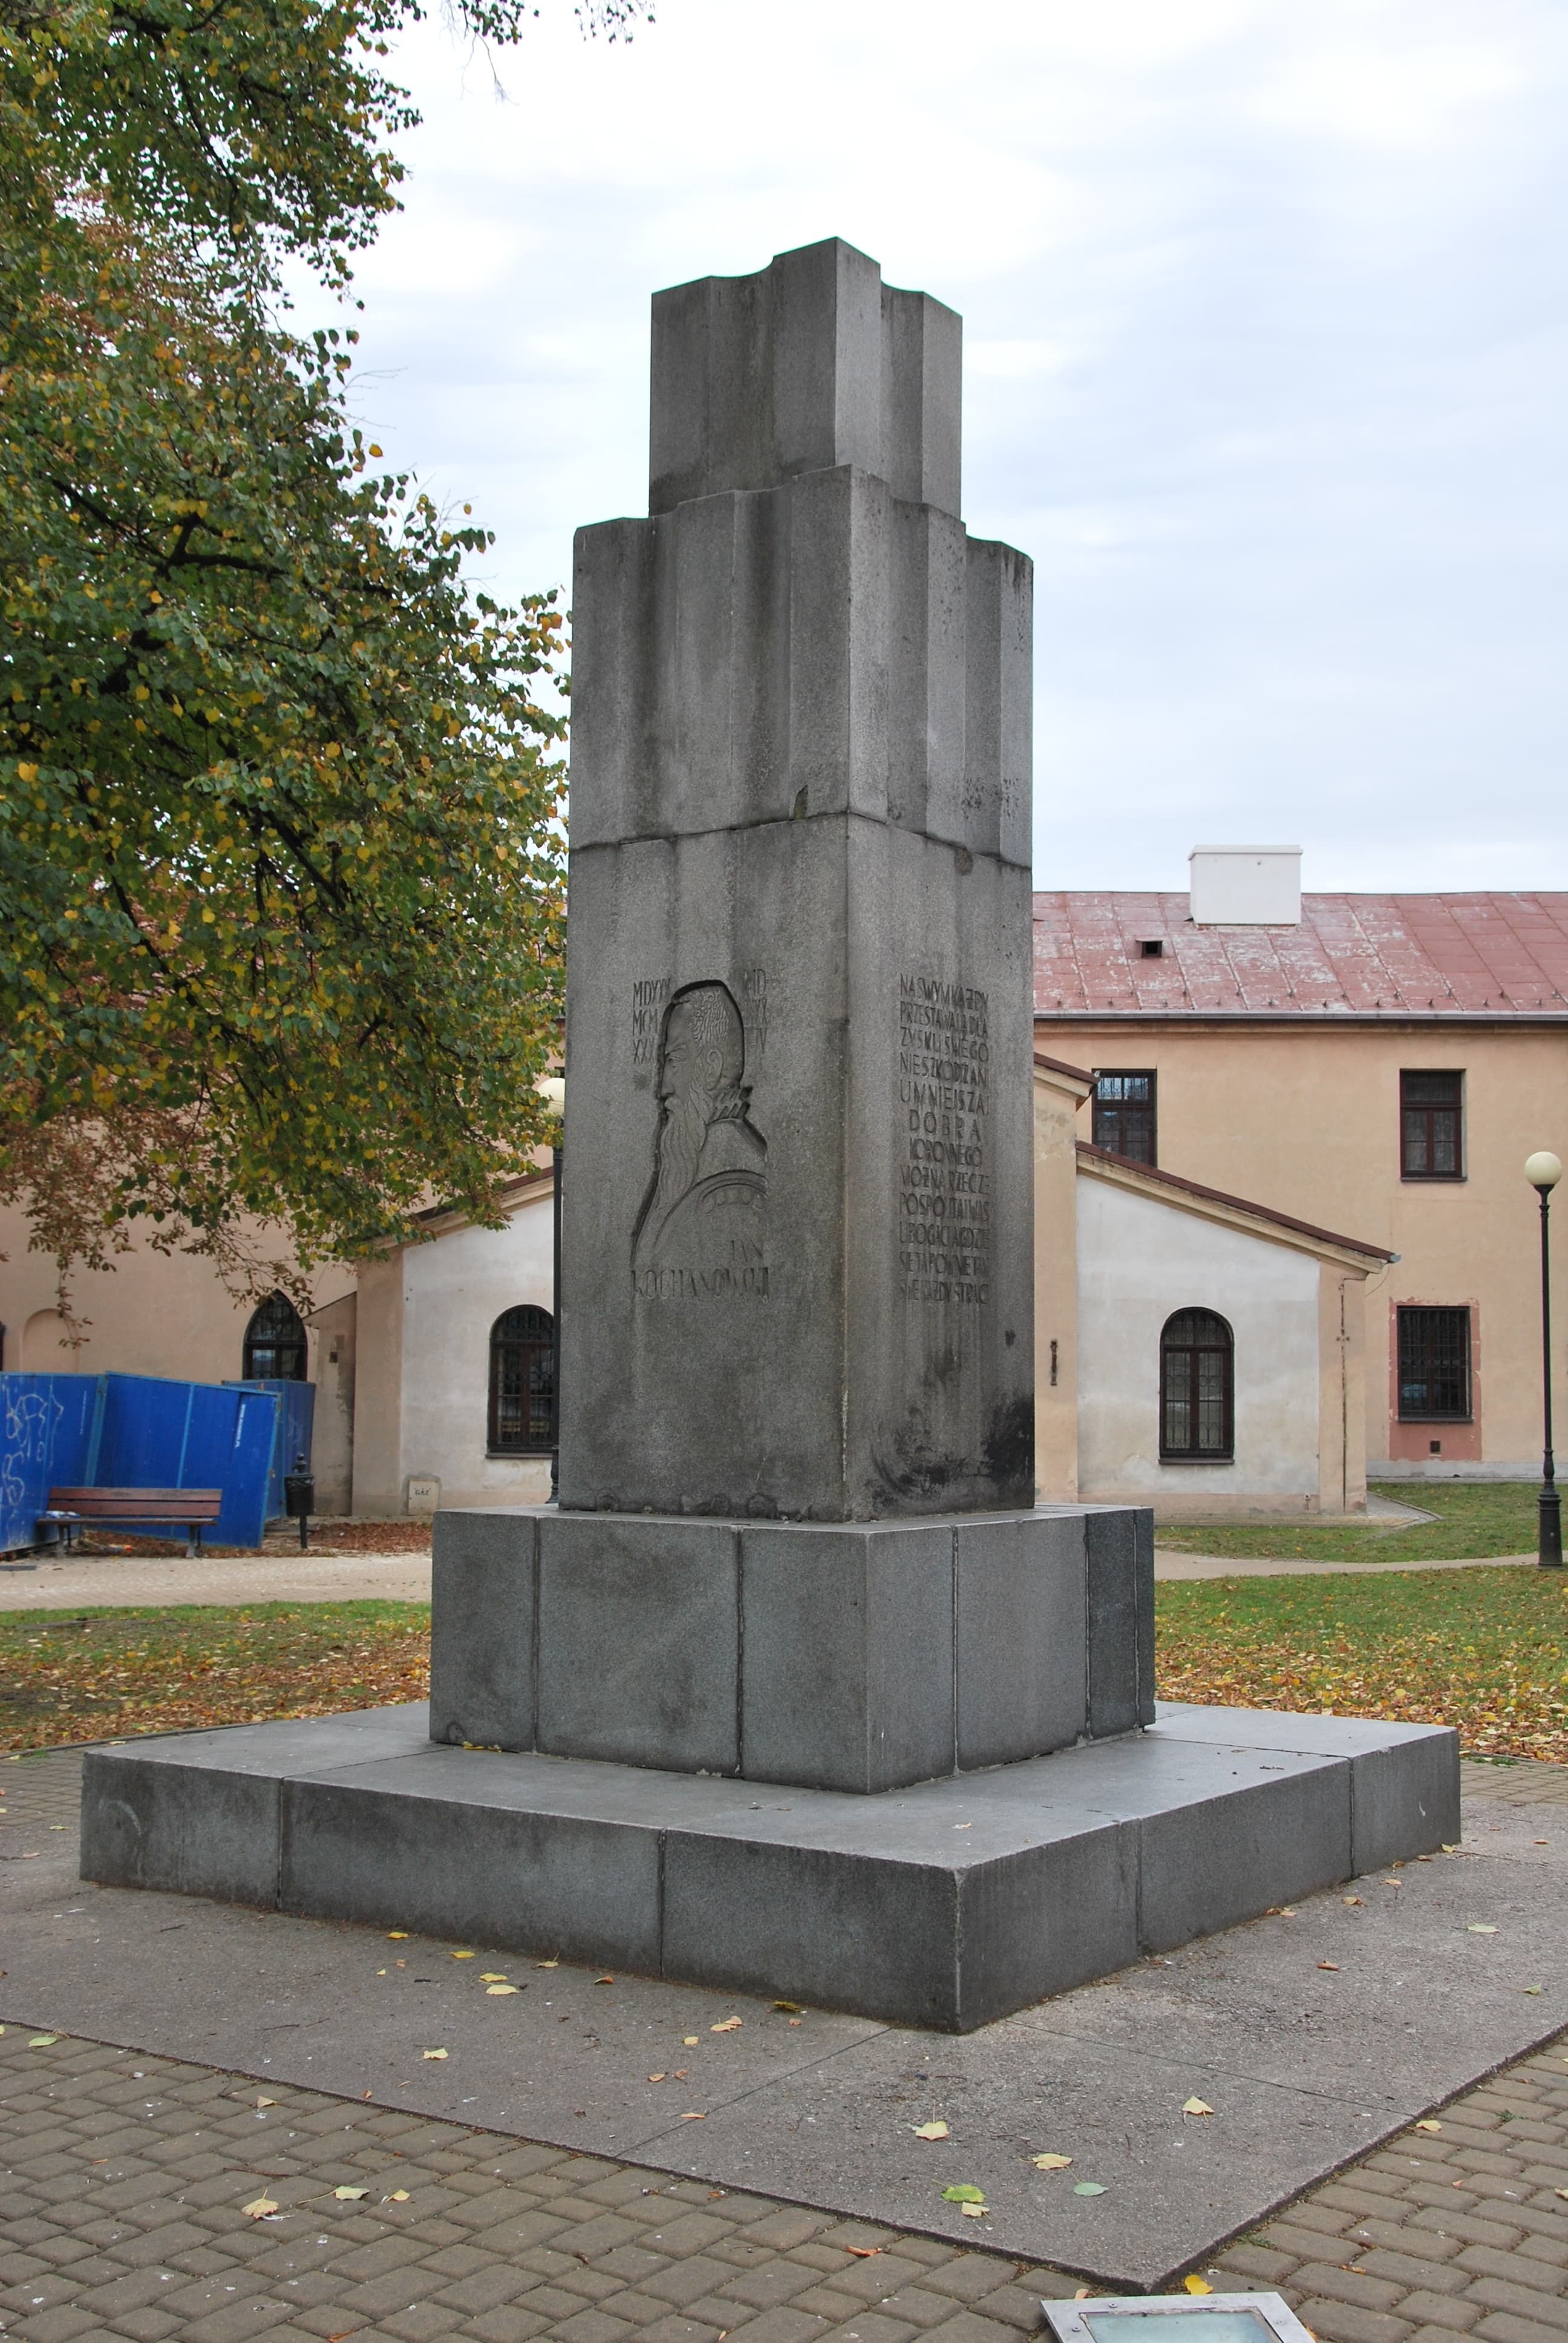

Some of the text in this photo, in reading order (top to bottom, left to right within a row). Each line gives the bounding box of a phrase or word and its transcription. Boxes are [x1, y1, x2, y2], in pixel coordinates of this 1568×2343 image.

[900, 973, 915, 997] NA
[633, 1009, 658, 1036] MCM
[969, 1016, 989, 1039] DLA
[633, 1038, 655, 1064] XXX
[900, 1026, 990, 1063] ZYSKU SWEGO
[900, 1052, 920, 1075] NIE
[970, 1066, 990, 1090] ANI
[909, 1109, 981, 1141] DOBRA
[969, 1199, 989, 1222] WAS
